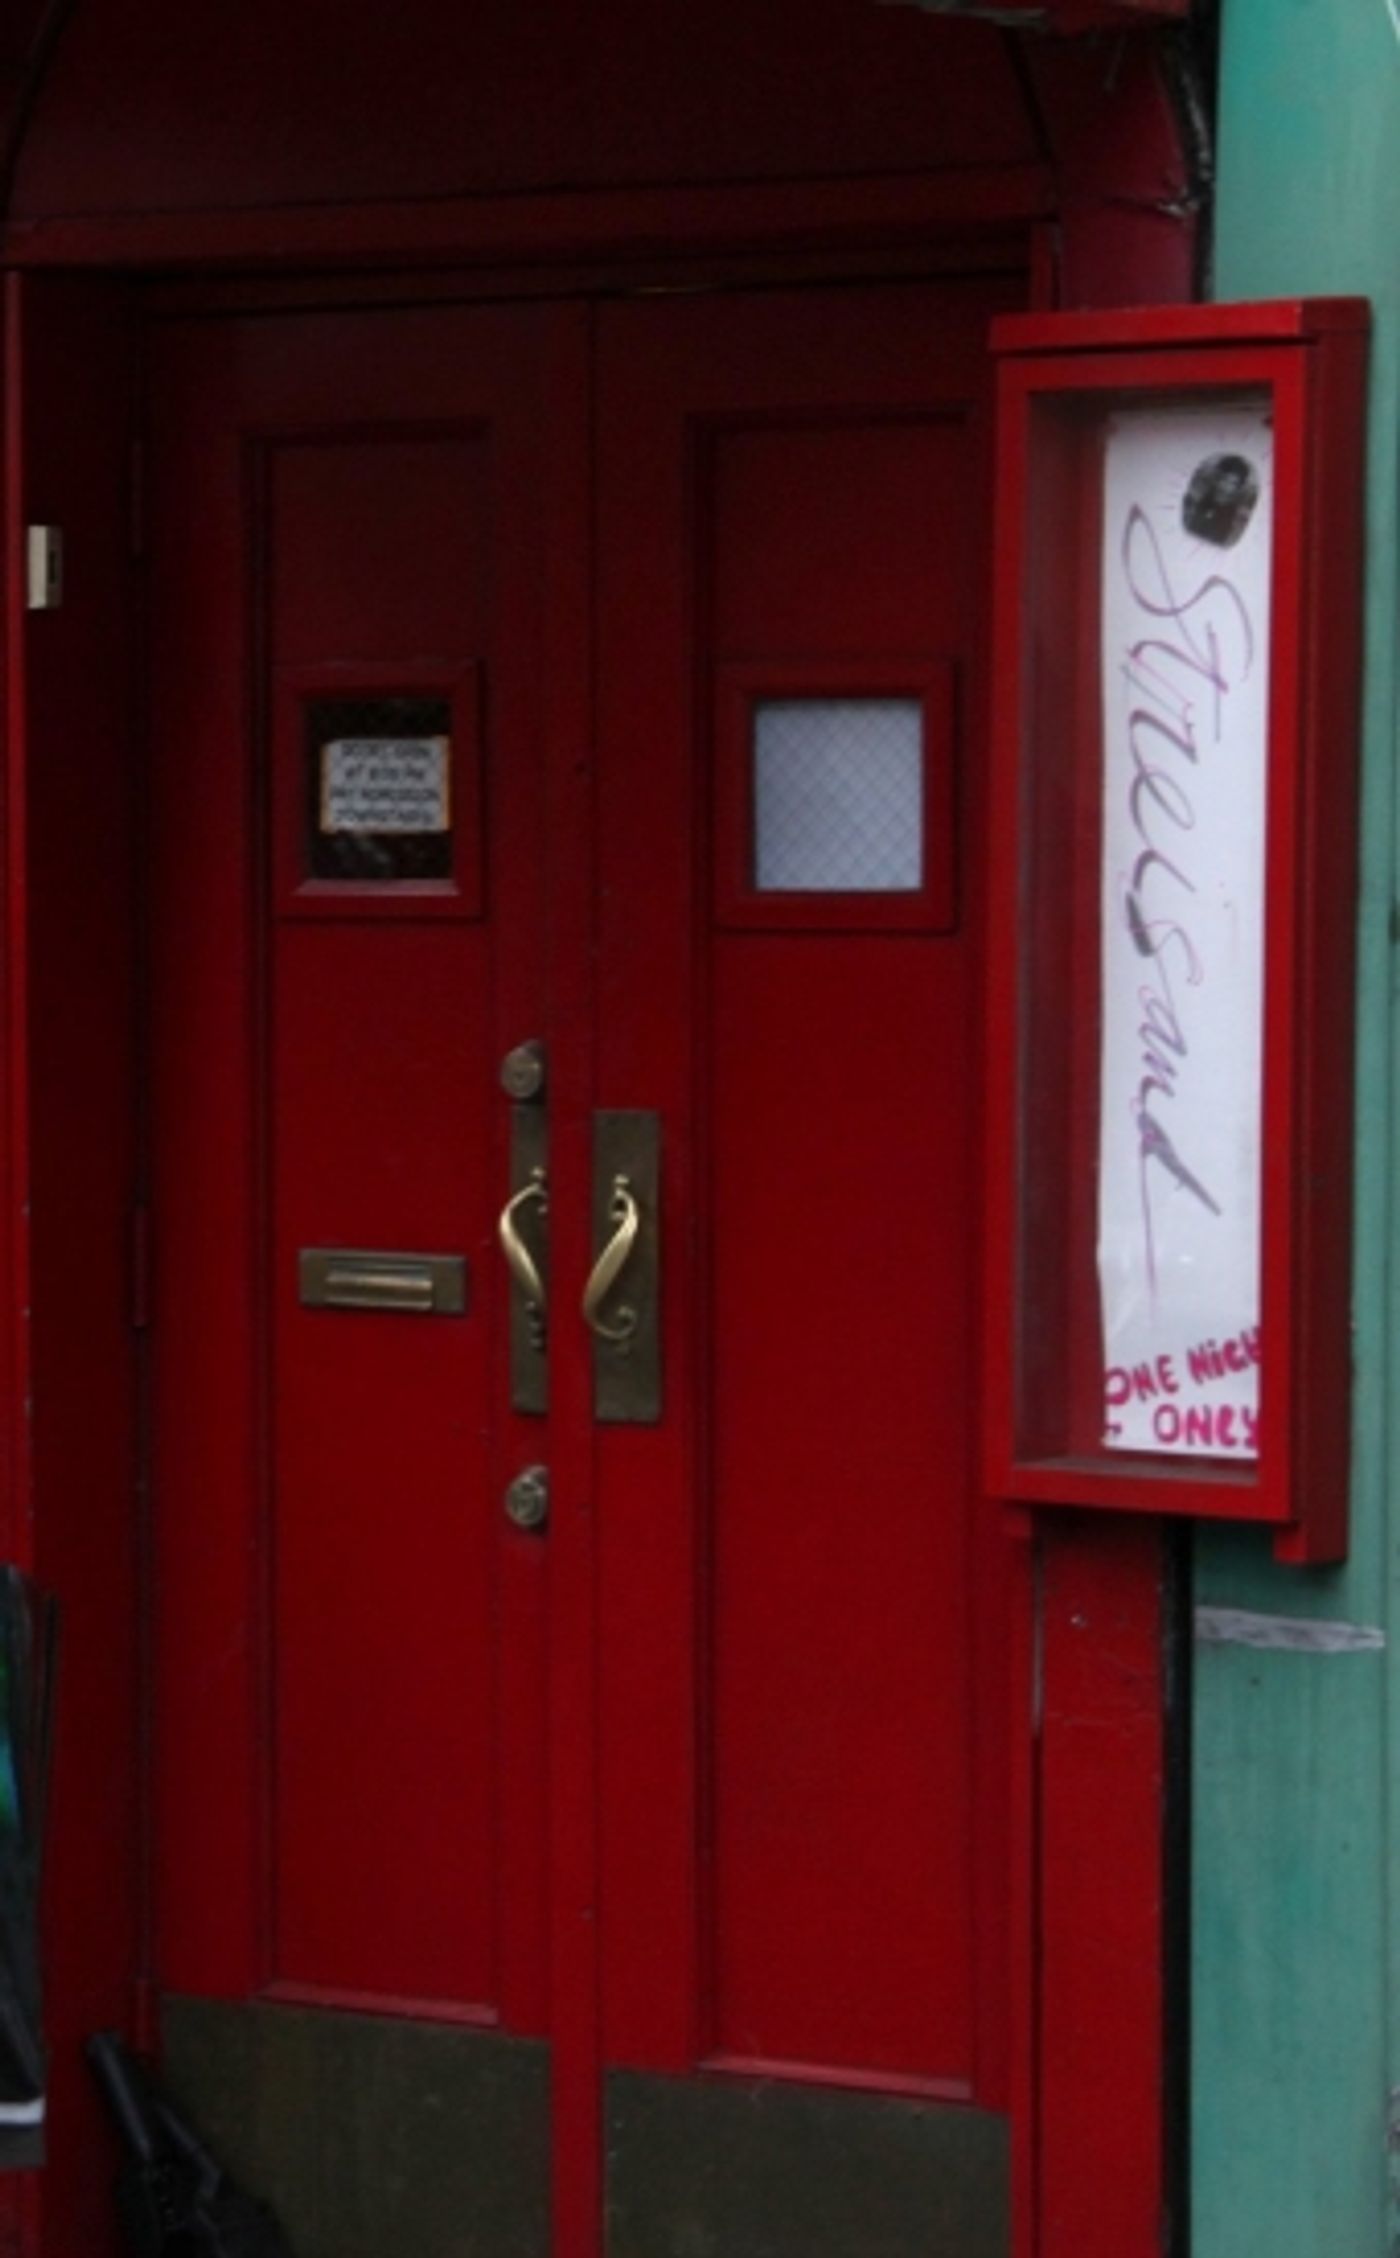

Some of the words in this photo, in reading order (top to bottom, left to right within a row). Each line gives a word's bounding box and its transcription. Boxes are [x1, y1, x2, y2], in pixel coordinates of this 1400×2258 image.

[1119, 503, 1253, 1306] Streisand
[1105, 1355, 1179, 1405] ONE
[1153, 1404, 1259, 1448] ONLY
